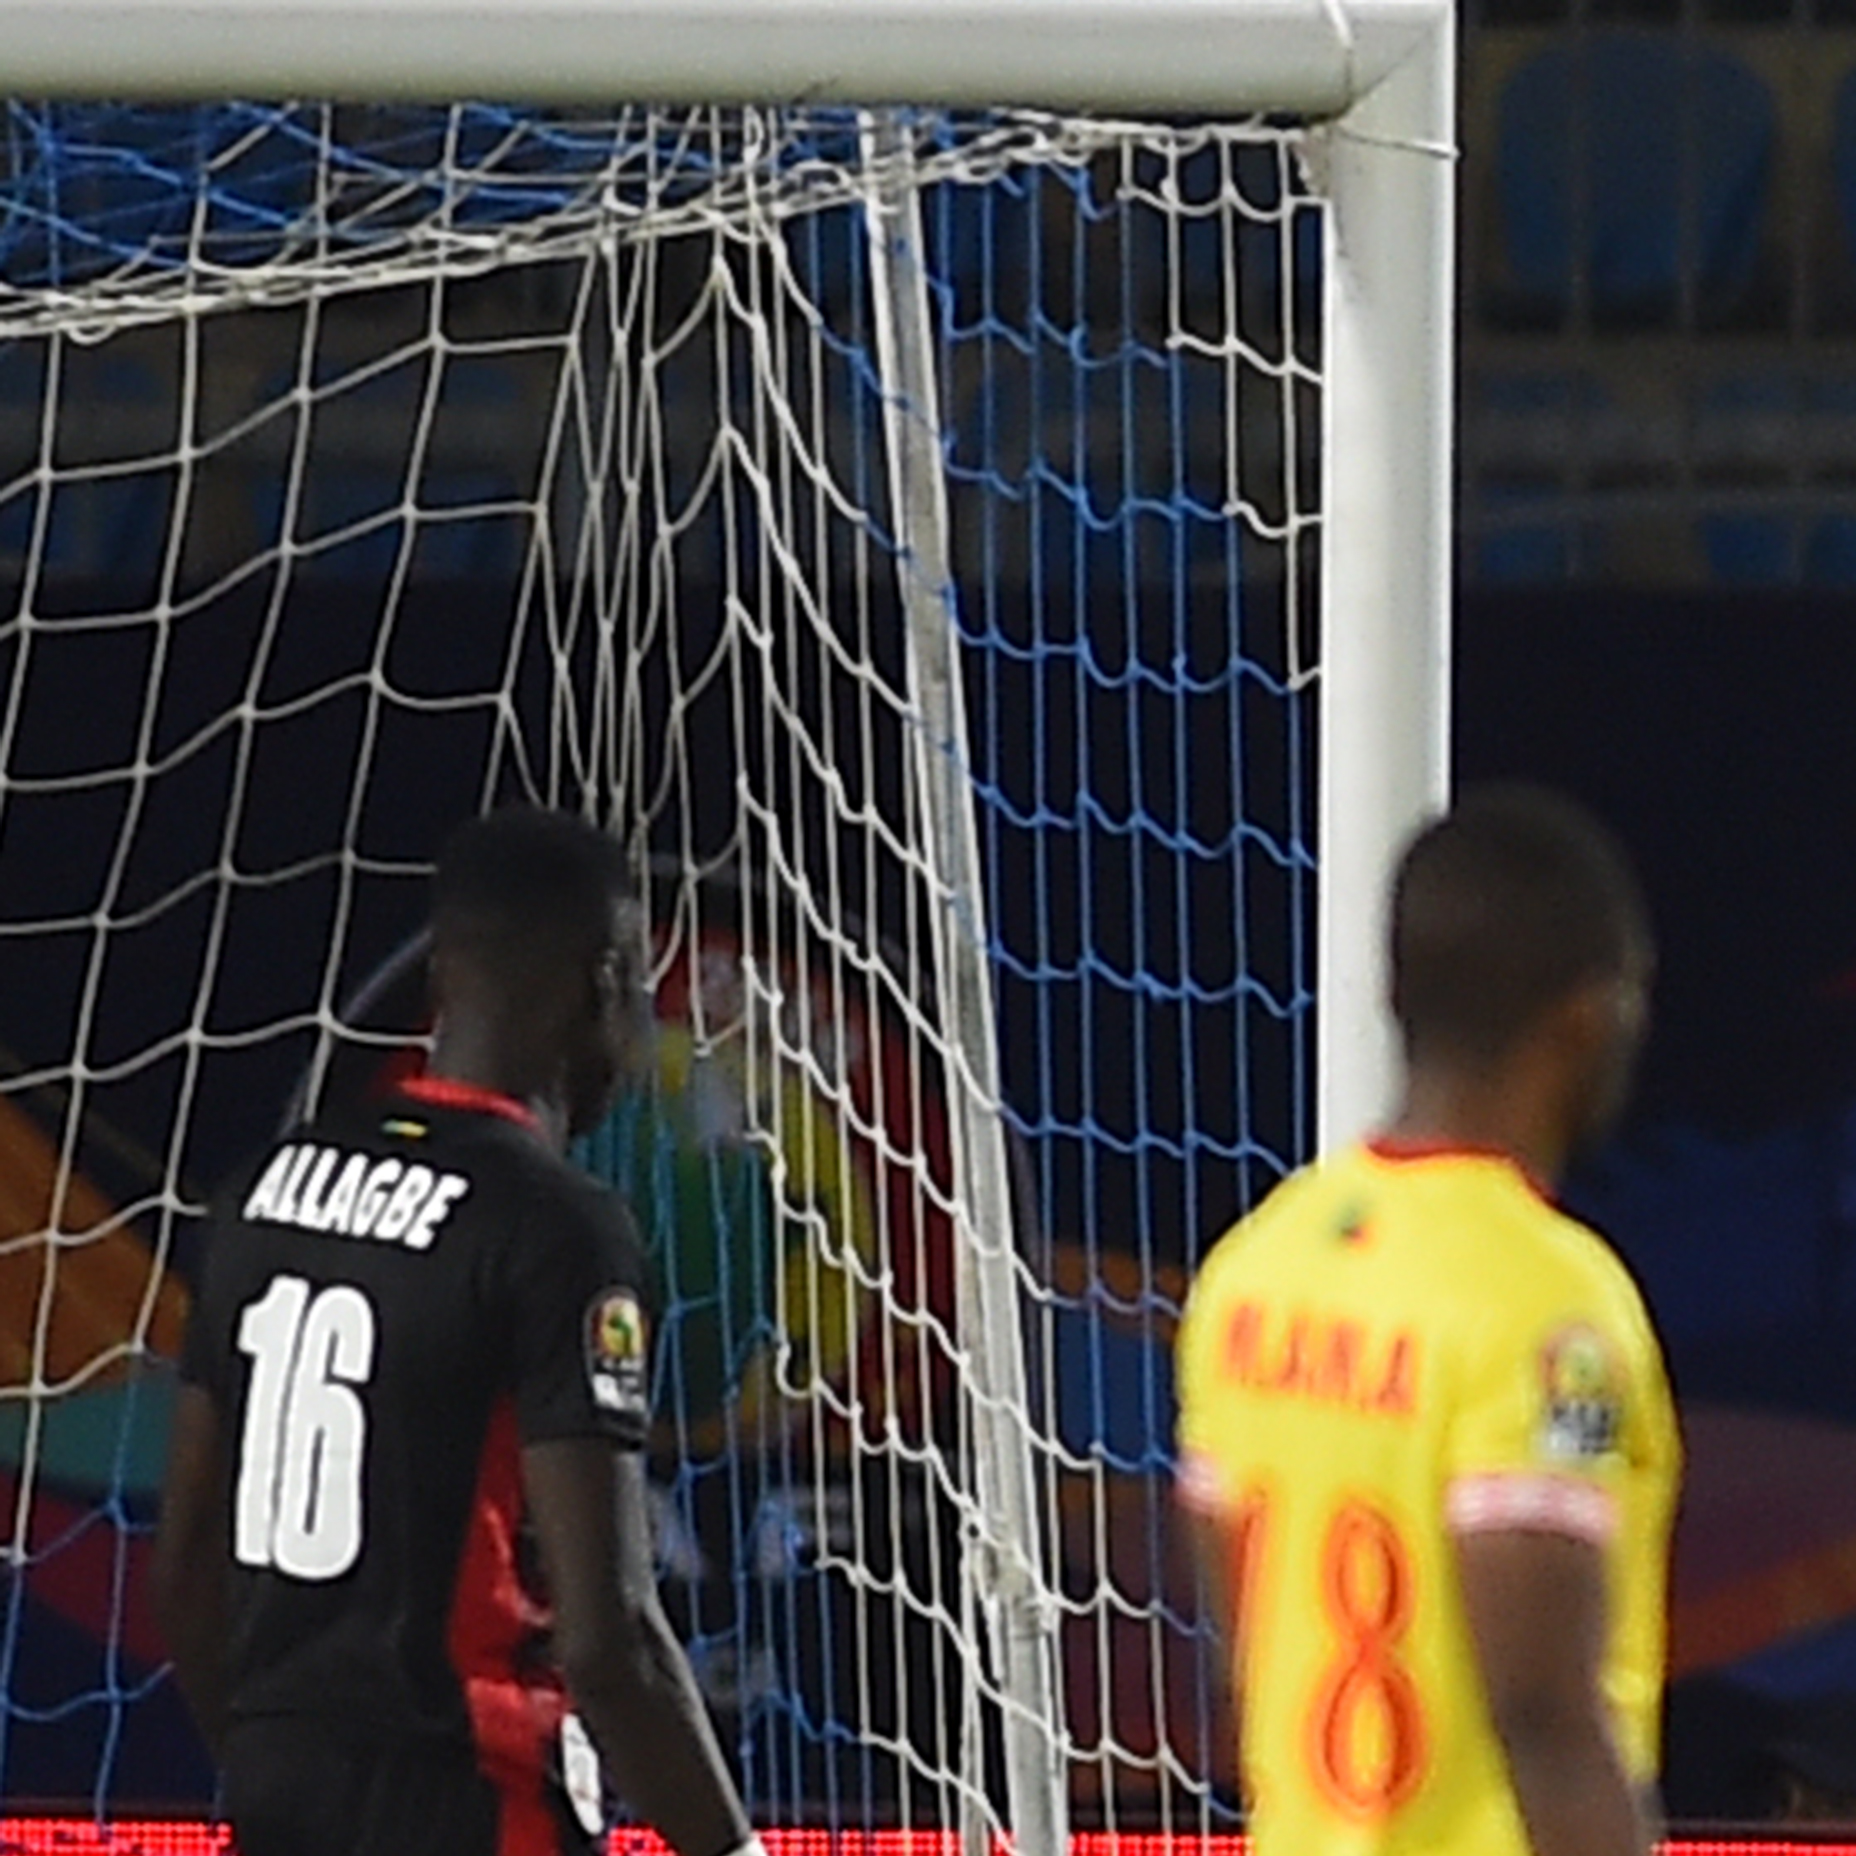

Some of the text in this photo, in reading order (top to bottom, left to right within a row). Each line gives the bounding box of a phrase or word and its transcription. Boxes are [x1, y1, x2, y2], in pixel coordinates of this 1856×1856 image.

[242, 1143, 470, 1250] ALLAGBE
[235, 1274, 376, 1581] 16
[1234, 1480, 1428, 1826] 18
